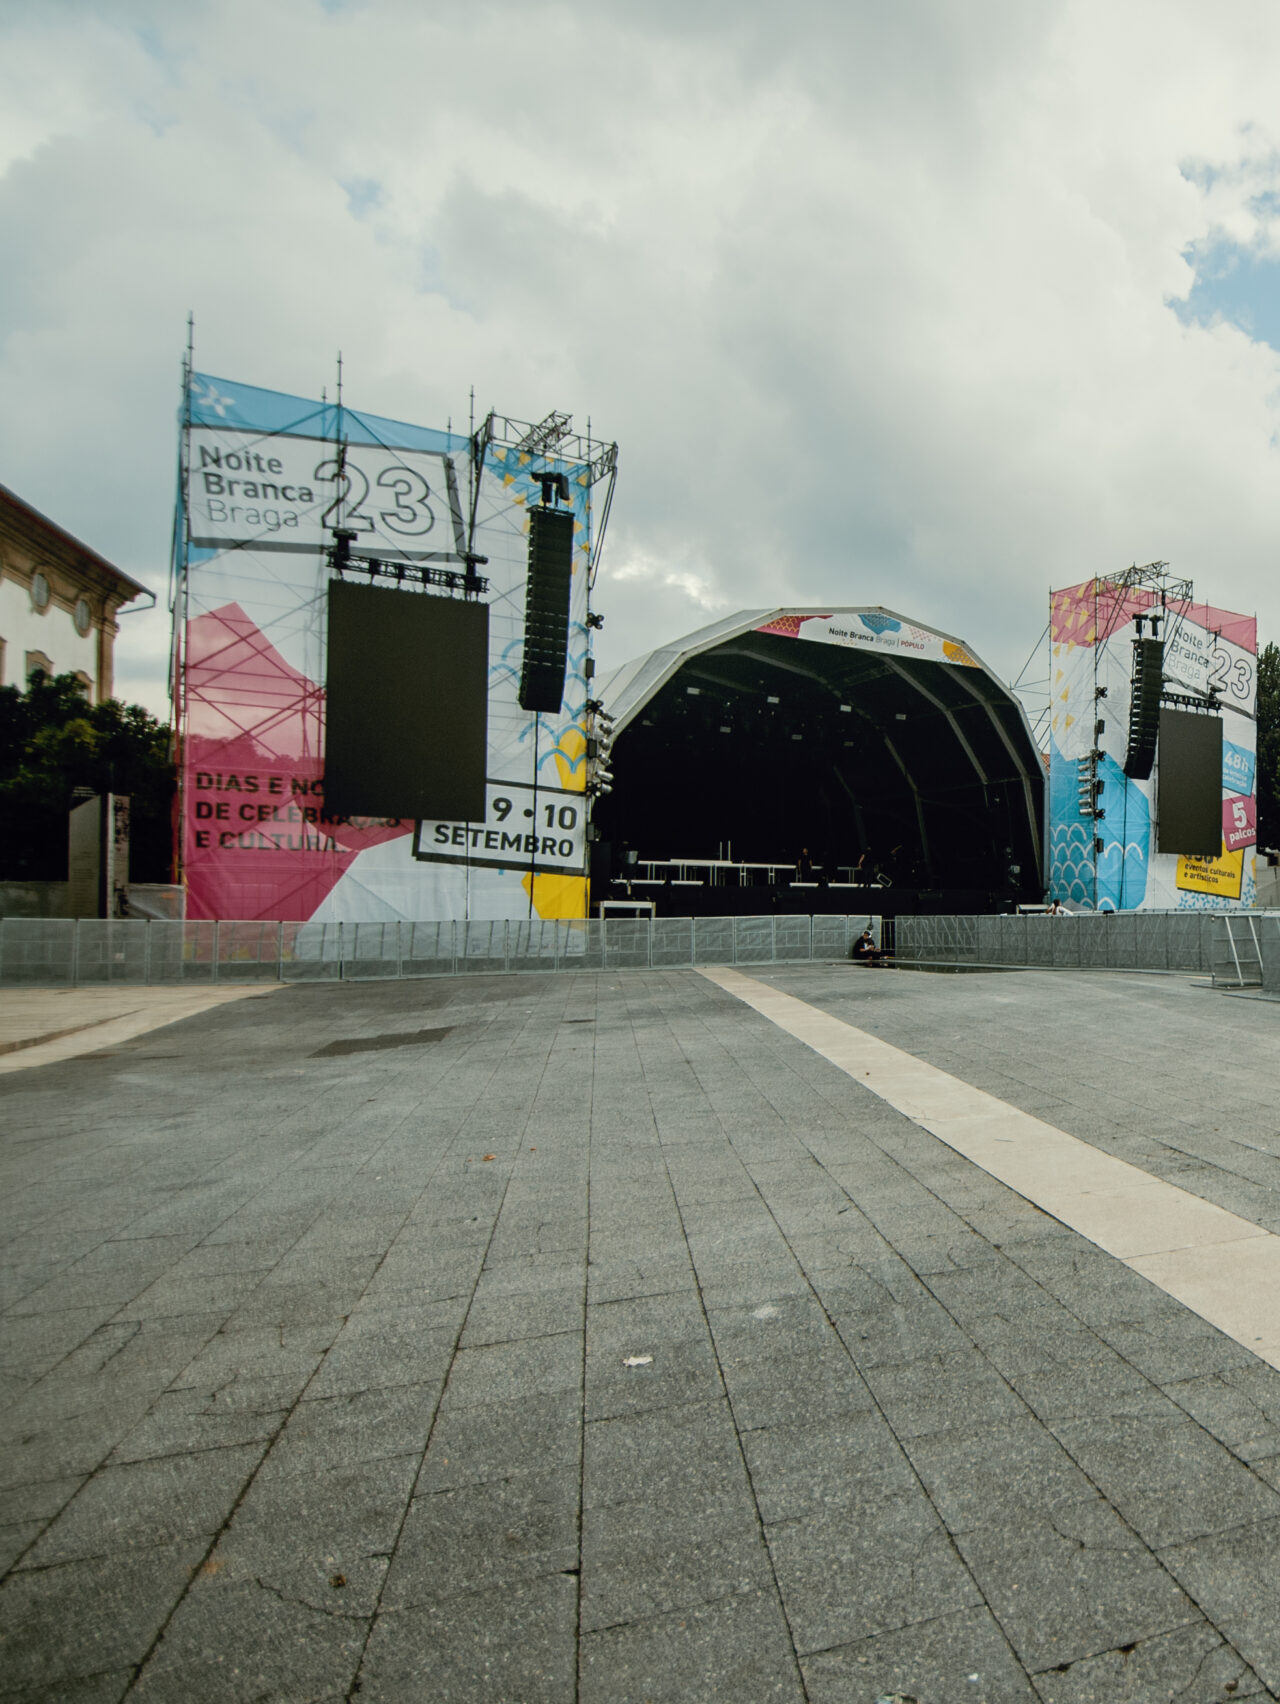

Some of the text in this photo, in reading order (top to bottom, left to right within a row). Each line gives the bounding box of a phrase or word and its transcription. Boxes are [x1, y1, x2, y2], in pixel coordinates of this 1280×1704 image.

[199, 445, 283, 475] Noite
[203, 472, 314, 503] Branca
[314, 460, 435, 536] 23
[207, 499, 299, 532] Braga
[828, 627, 848, 637] Noite
[849, 631, 874, 642] Branca
[1175, 625, 1203, 649] Noite
[1168, 653, 1201, 680] Braga
[1171, 640, 1209, 668] Branca
[1207, 648, 1252, 700] 23
[1224, 751, 1249, 773] 48h
[196, 772, 259, 794] DIAS
[268, 777, 283, 794] E
[196, 801, 230, 820] DE
[492, 797, 577, 830] 9 10
[1232, 801, 1247, 828] 5
[196, 831, 209, 848] E
[433, 824, 574, 857] SETEMBRO
[1229, 828, 1256, 844] palcos
[1185, 863, 1235, 879] eventos culturais
